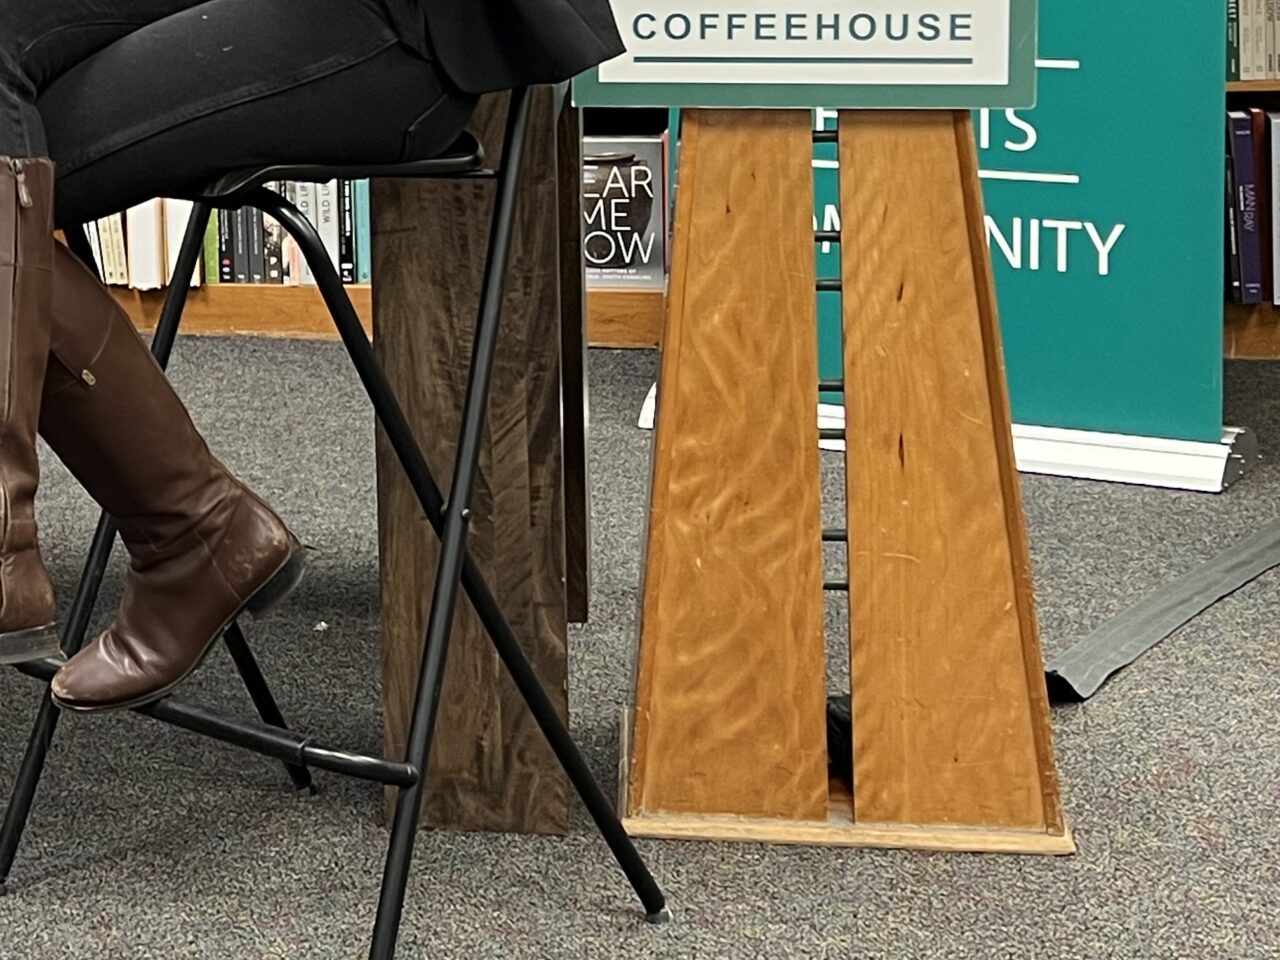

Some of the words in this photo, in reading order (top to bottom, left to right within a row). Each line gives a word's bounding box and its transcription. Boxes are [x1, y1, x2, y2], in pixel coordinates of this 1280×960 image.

[632, 12, 973, 41] COFFEEHOUSE
[1244, 183, 1256, 211] MAN
[1243, 212, 1255, 232] RAY
